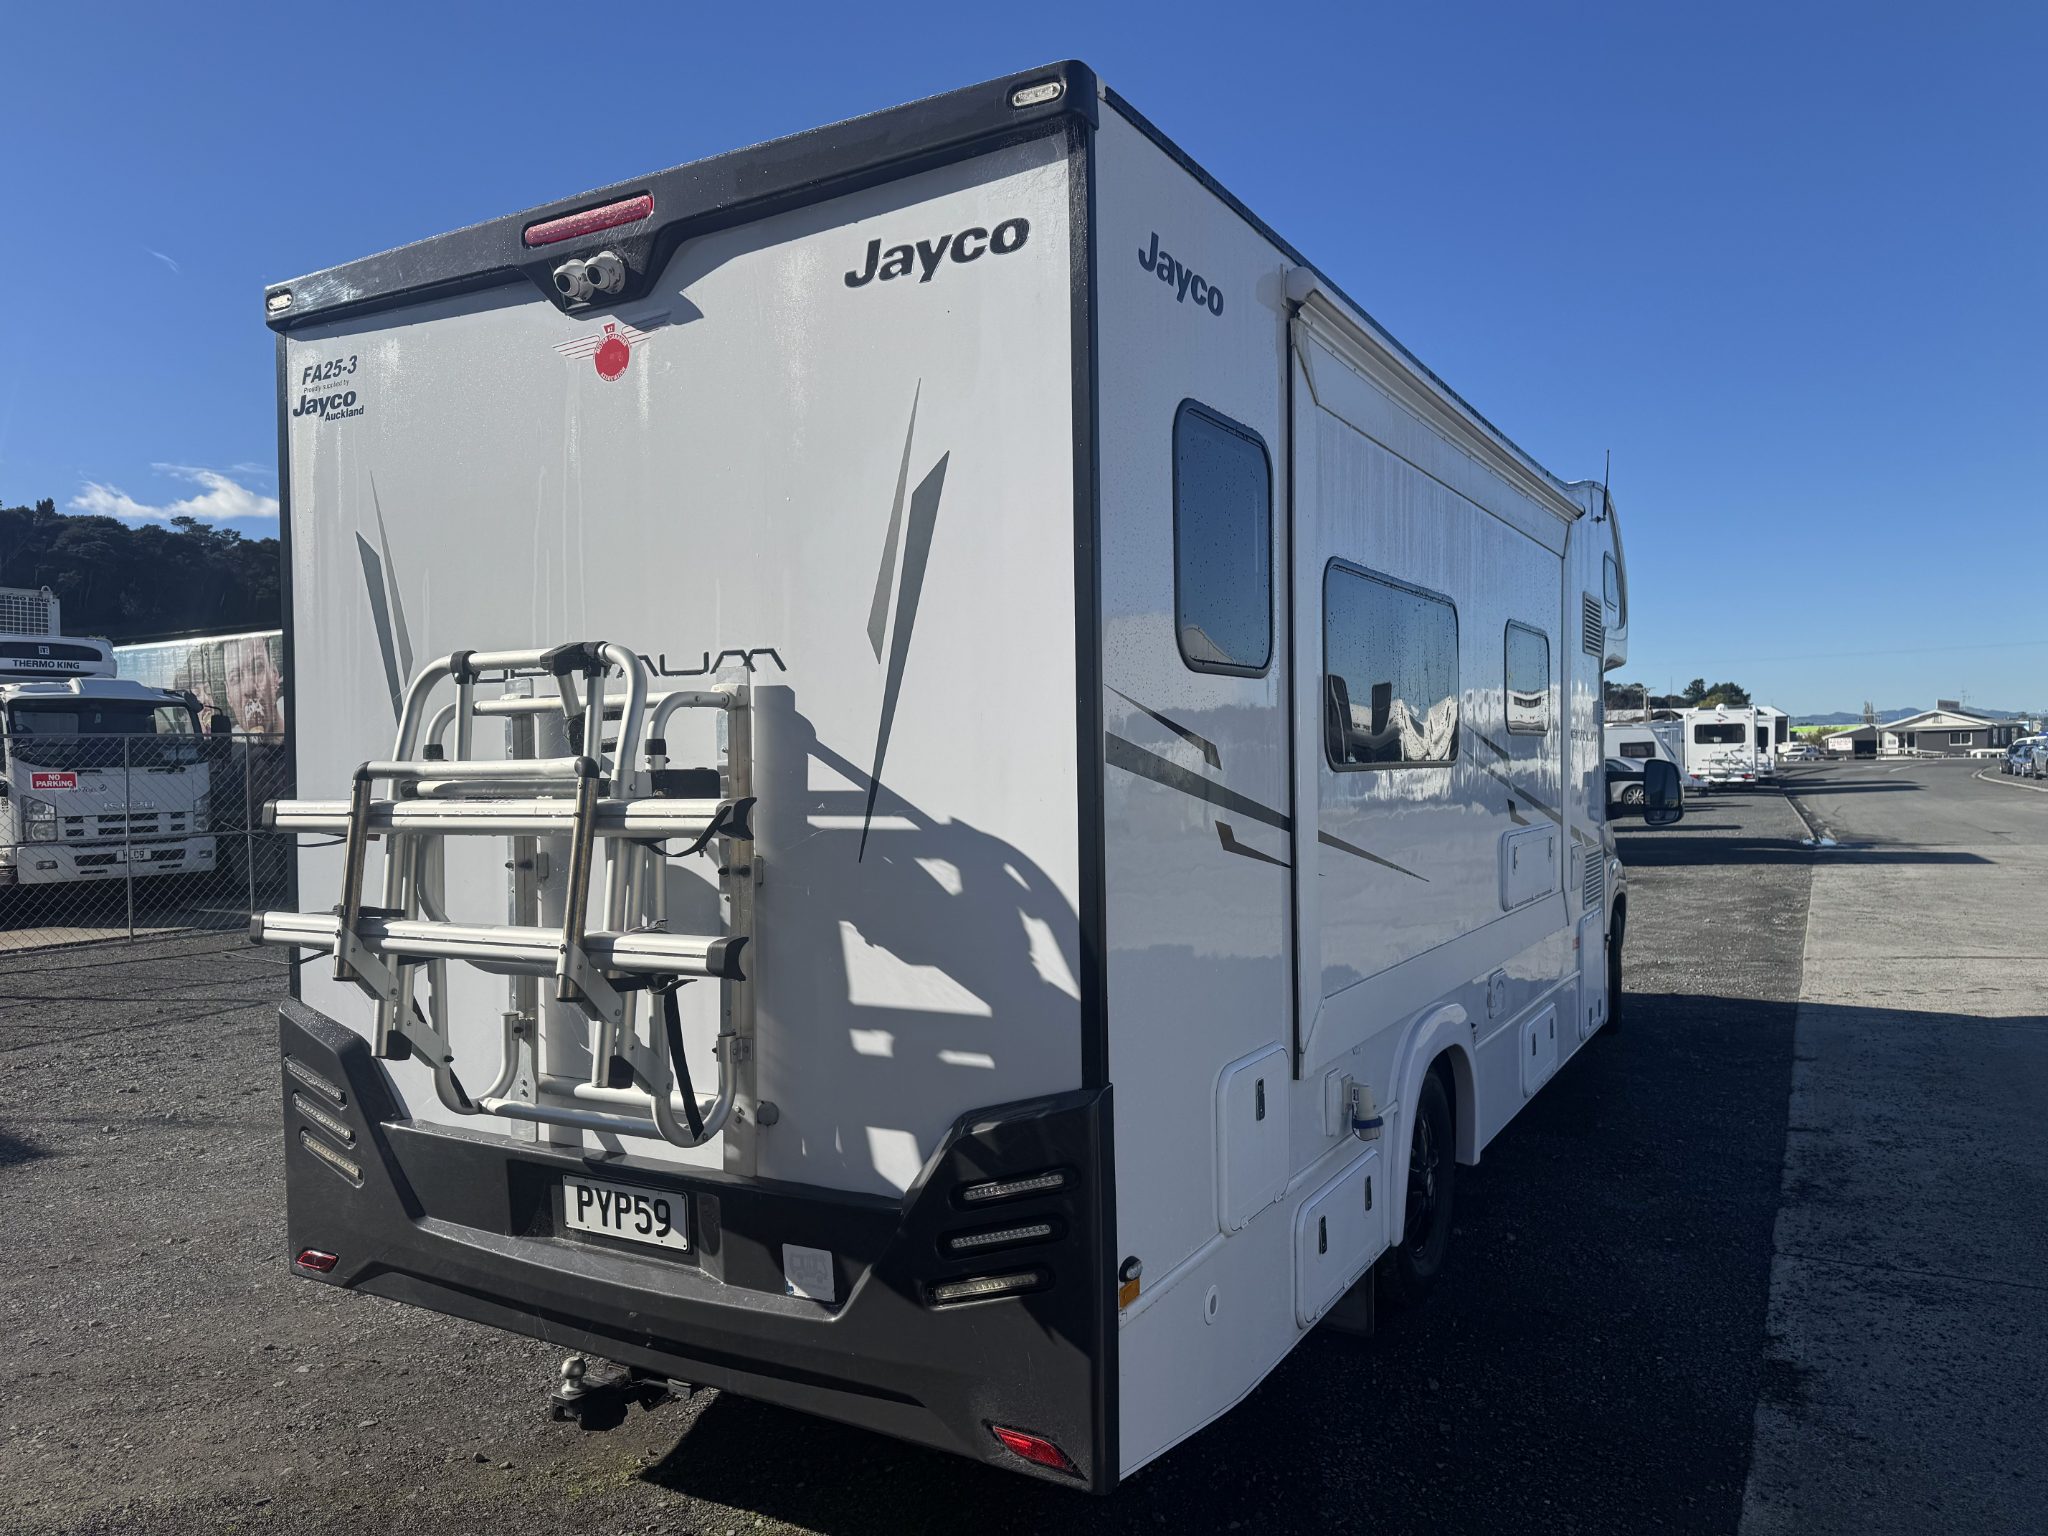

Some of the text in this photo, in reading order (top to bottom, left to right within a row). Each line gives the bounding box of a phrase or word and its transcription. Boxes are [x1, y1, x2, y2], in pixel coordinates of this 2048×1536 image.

[844, 217, 1030, 288] Jayco
[1138, 231, 1224, 317] Jayco
[302, 355, 357, 385] FA25-3
[292, 390, 357, 417] Jayco
[325, 405, 364, 422] Auckland
[12, 660, 80, 669] THERMO KING
[576, 1185, 671, 1237] PYP59
